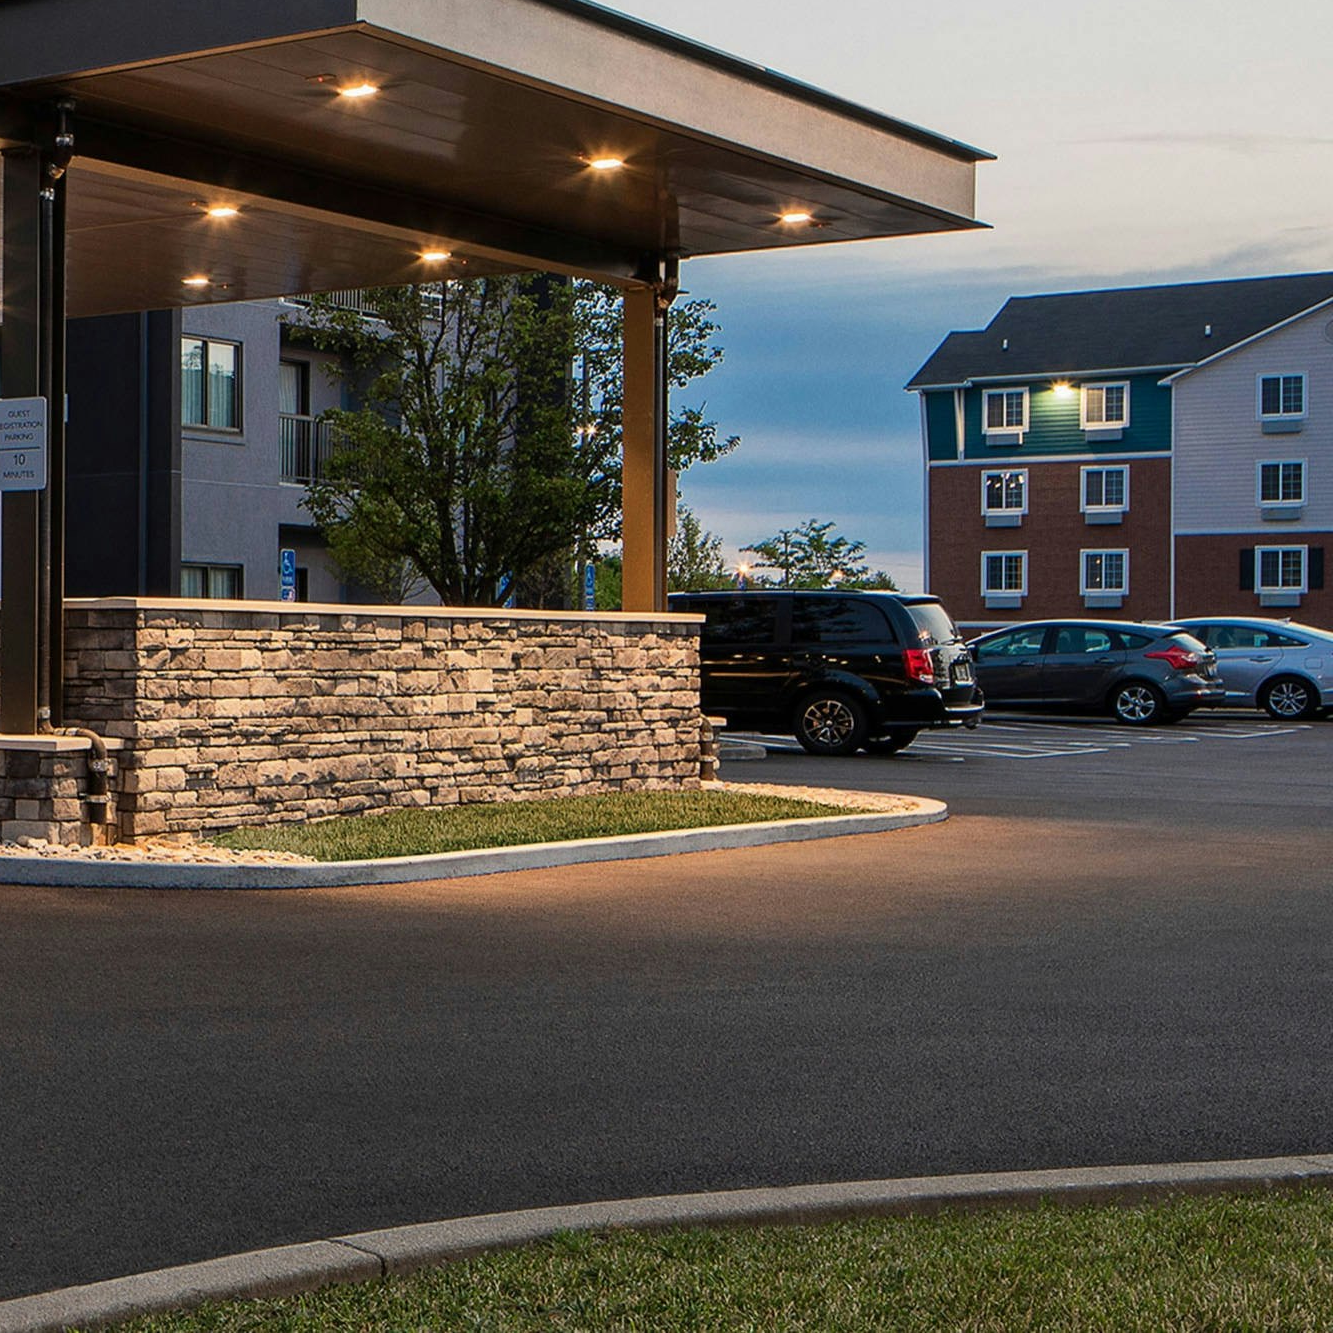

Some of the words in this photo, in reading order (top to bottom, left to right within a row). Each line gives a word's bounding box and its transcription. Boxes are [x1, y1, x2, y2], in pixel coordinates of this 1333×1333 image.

[8, 410, 30, 418] GUEST
[5, 433, 34, 441] PARKING
[14, 454, 26, 465] 10
[3, 470, 35, 479] MINUTES
